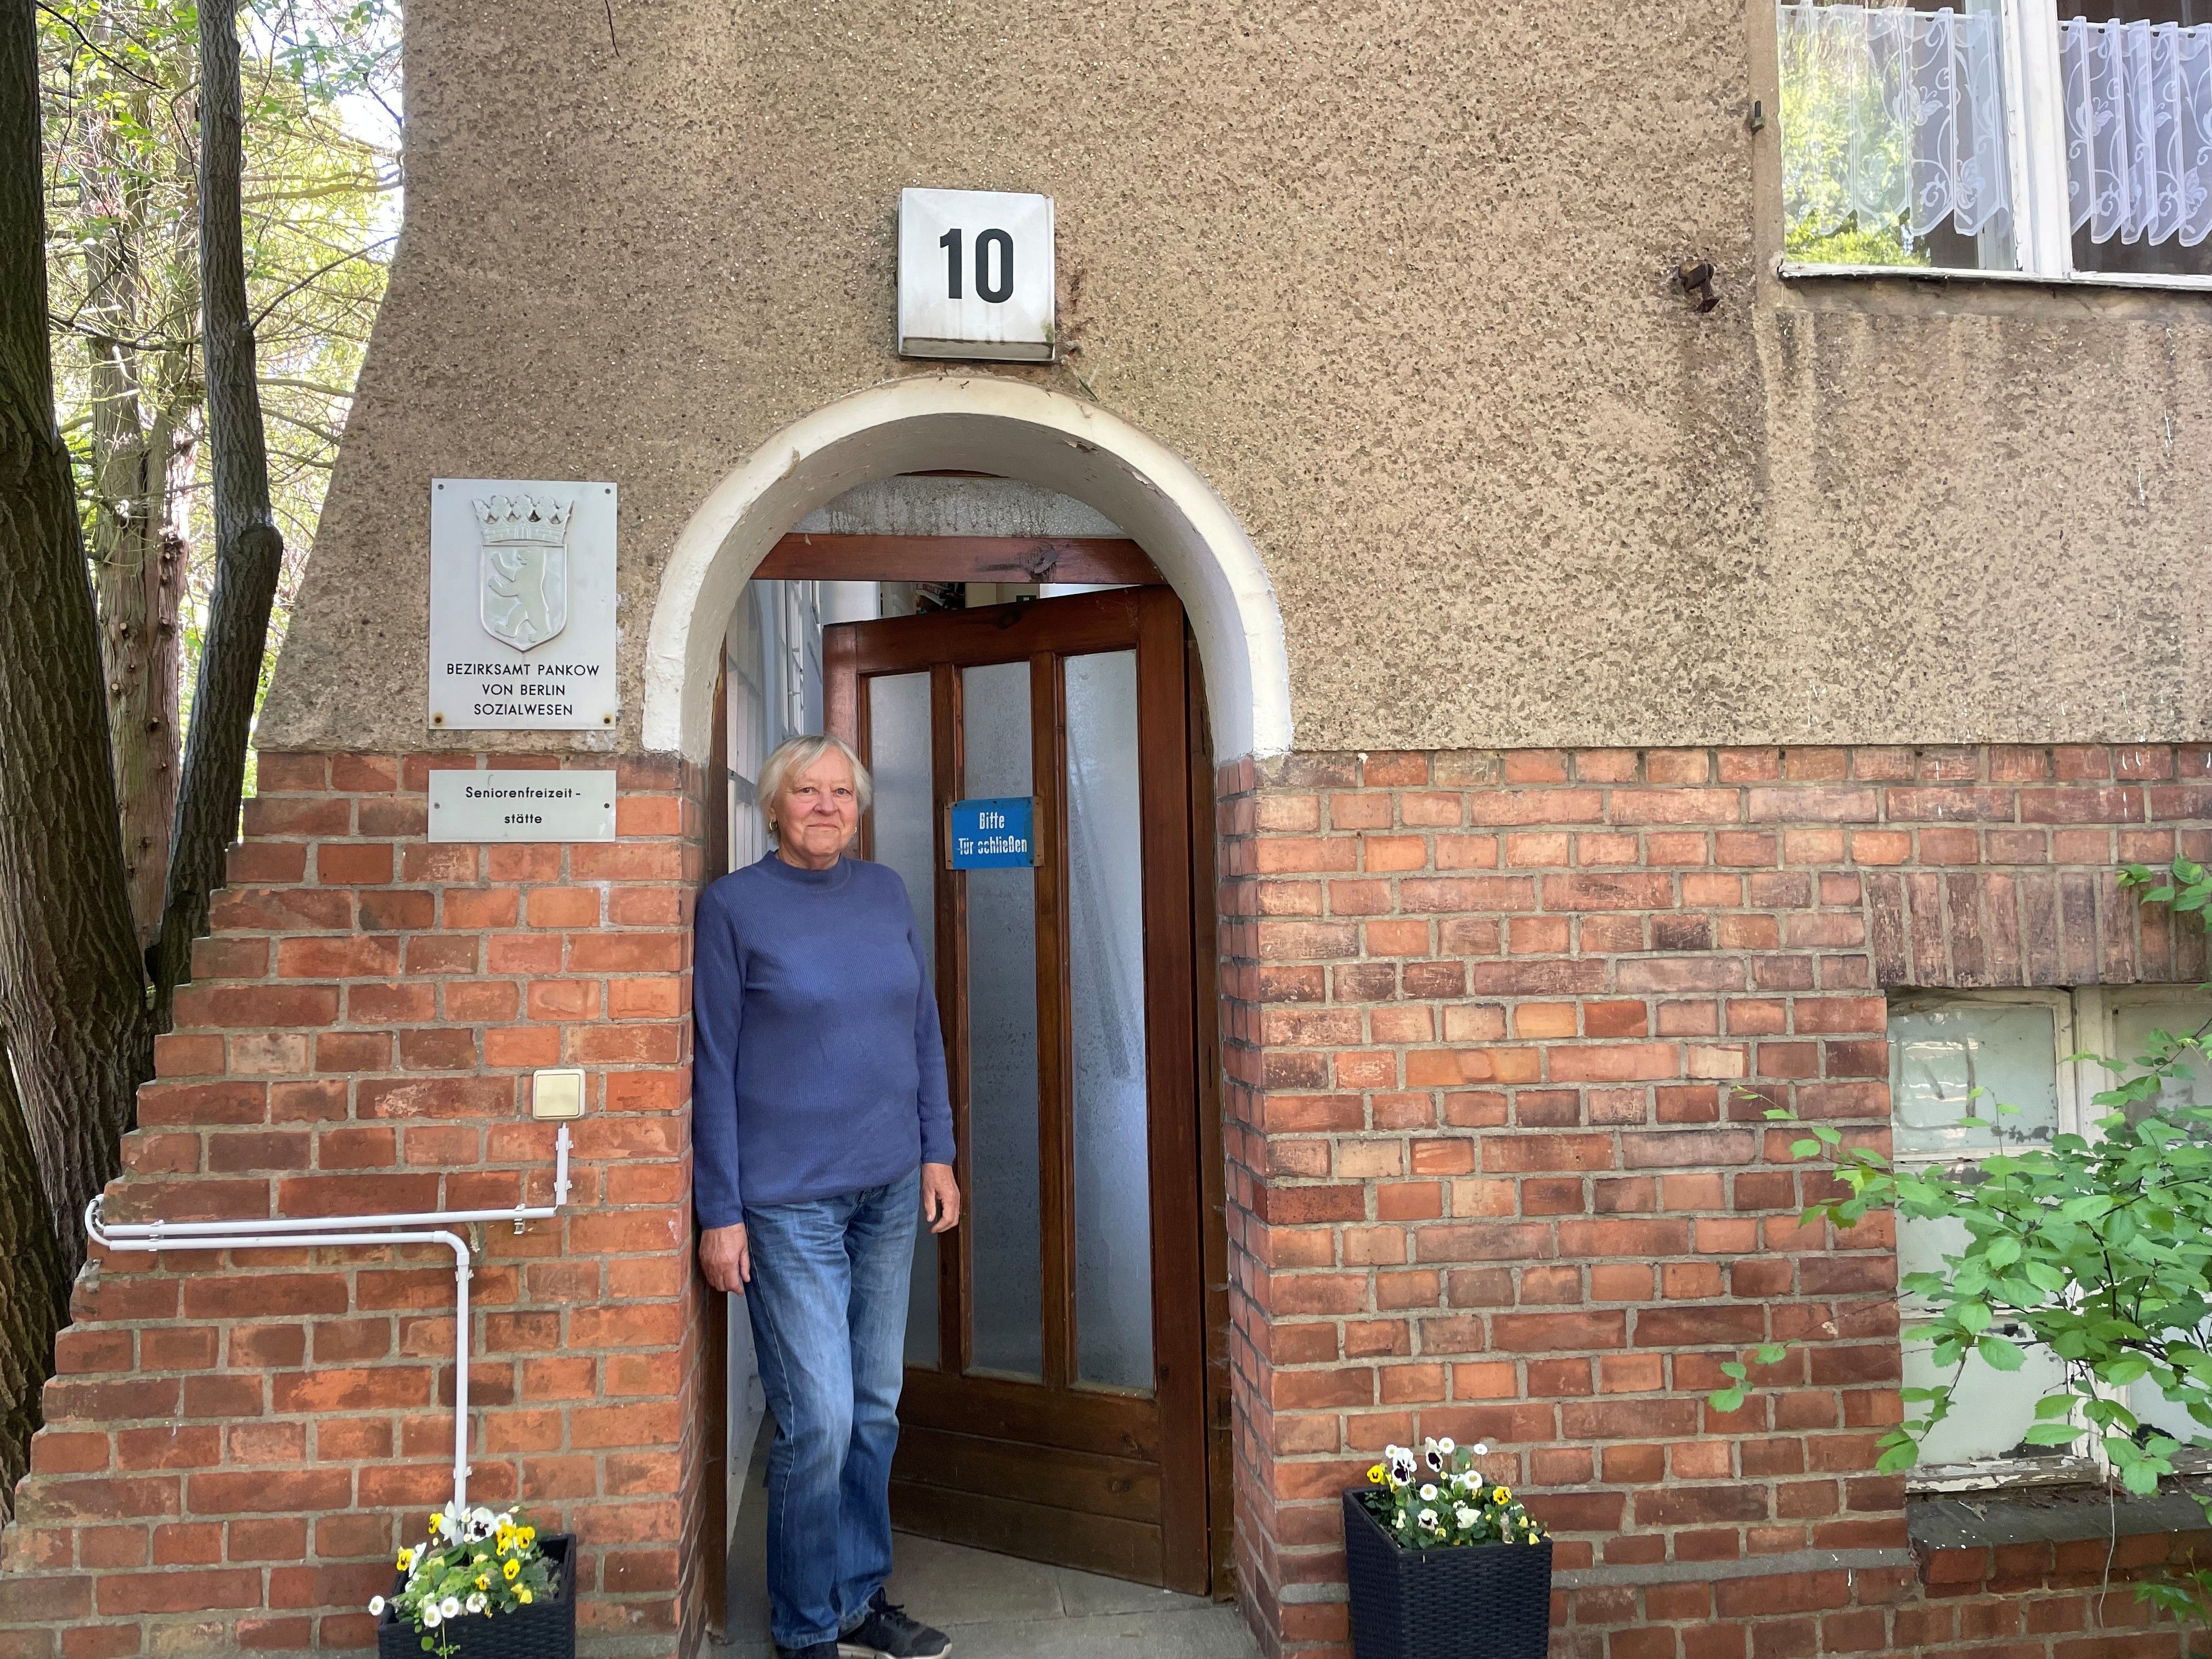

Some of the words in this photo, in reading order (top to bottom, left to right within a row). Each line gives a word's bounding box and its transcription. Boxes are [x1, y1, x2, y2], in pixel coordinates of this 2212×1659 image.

[940, 228, 1013, 303] 10
[447, 663, 531, 675] BEZIRKSAMT
[538, 664, 600, 676] PANKOW
[482, 684, 513, 695] VON
[521, 685, 565, 696] BERLIN
[474, 704, 572, 715] SOZIALWESEN
[504, 814, 543, 823] stätte
[979, 812, 1005, 830] Bitte
[958, 838, 974, 855] Tür
[978, 836, 1027, 854] schließen
